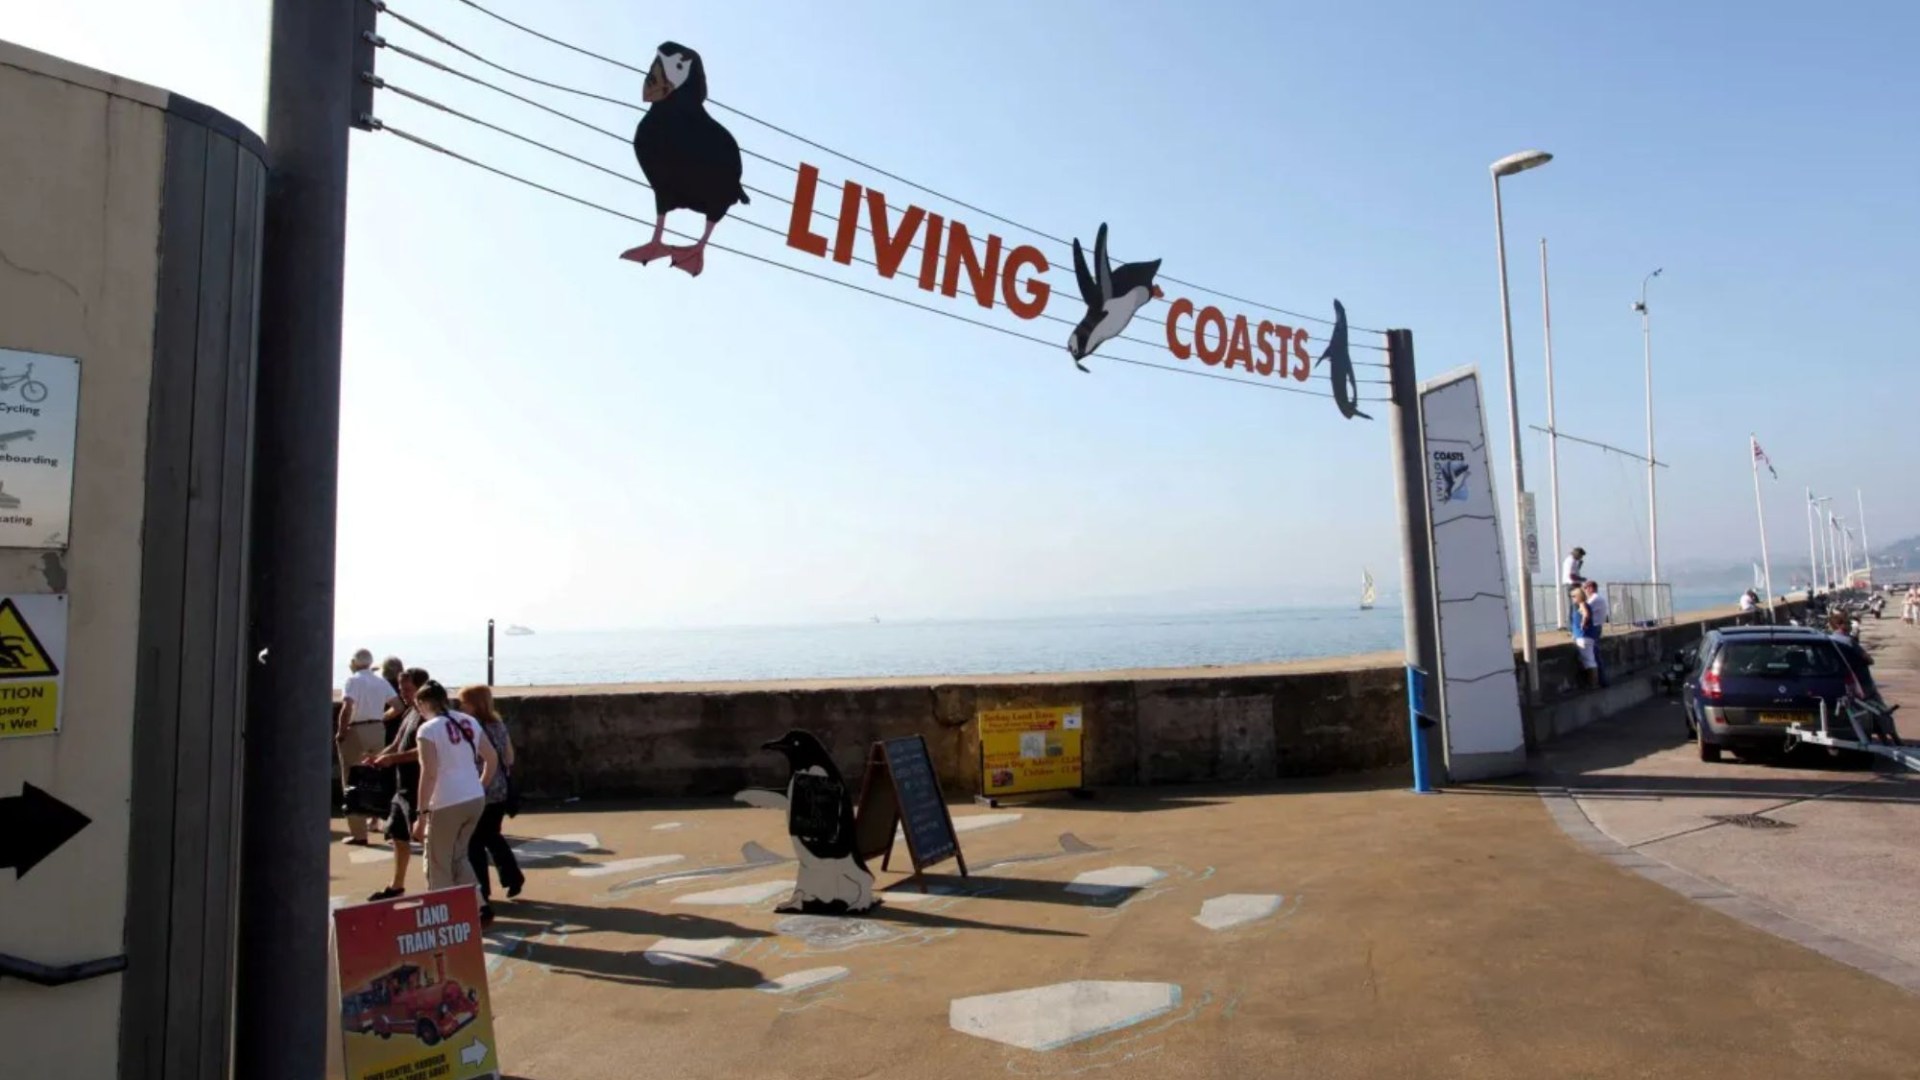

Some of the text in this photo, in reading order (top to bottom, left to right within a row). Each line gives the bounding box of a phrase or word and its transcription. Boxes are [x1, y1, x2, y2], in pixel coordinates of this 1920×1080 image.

[786, 162, 1311, 382] LIVING COASTS
[0, 402, 40, 416] Cycling
[1433, 450, 1464, 461] COASTS
[10, 718, 38, 730] Wet
[415, 904, 449, 928] LAND
[396, 922, 471, 955] TRAIN STOP
